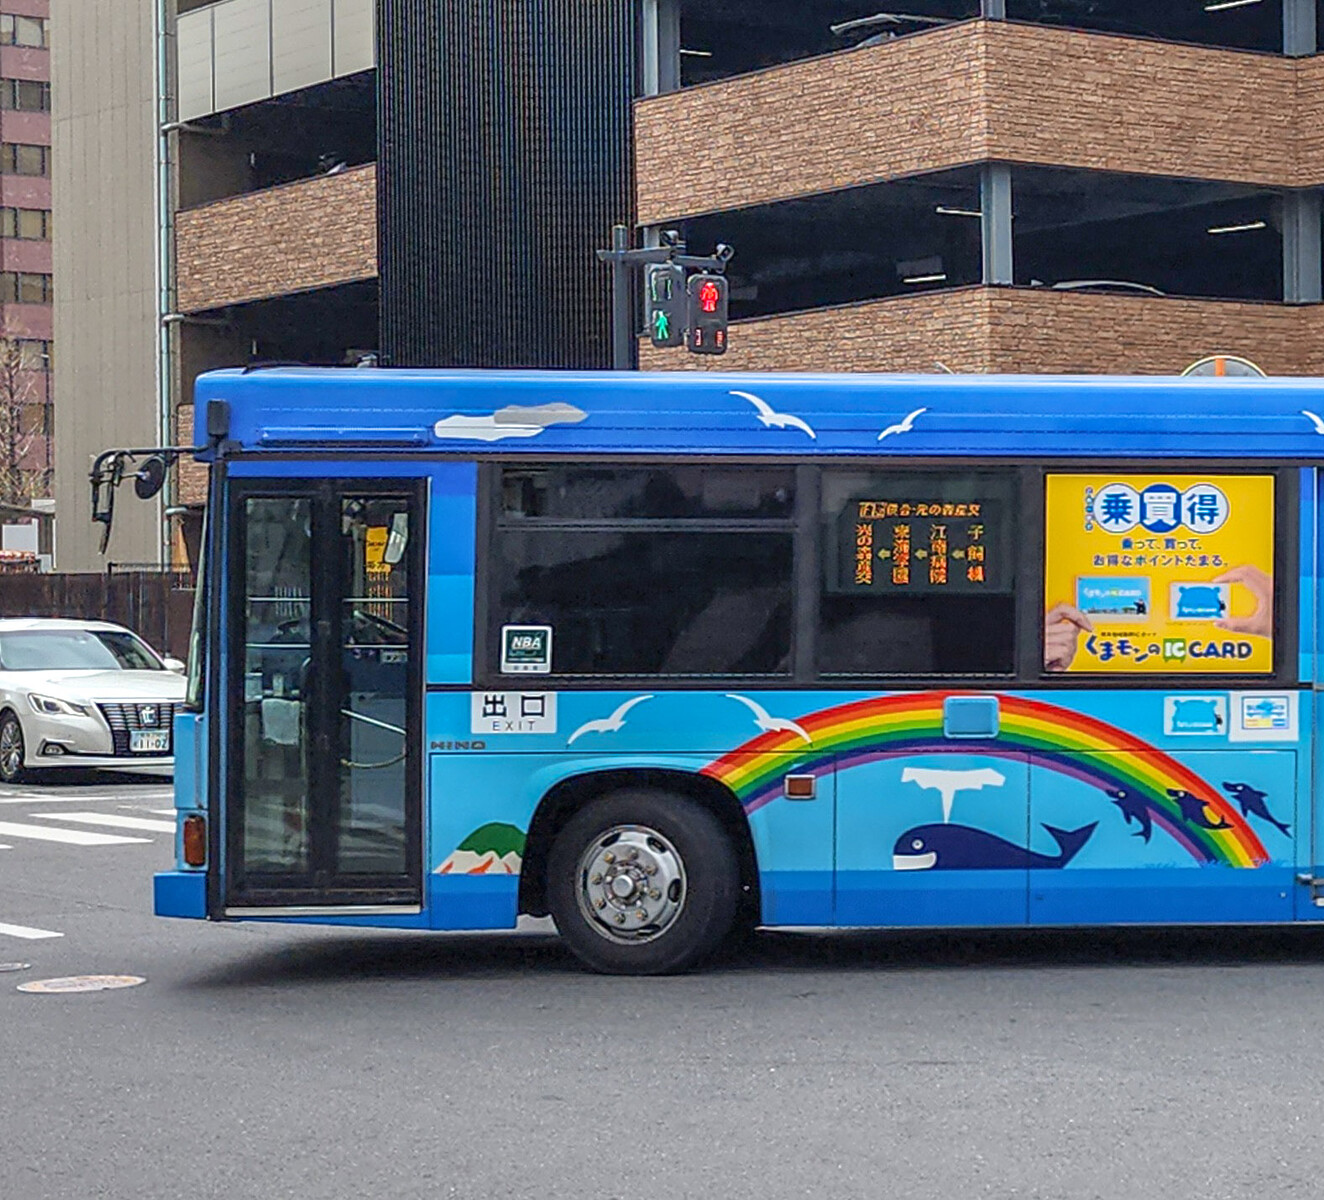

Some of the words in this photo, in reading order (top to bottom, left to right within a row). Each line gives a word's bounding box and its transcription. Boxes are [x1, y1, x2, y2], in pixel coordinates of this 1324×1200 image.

[511, 636, 542, 650] NBA
[1188, 641, 1252, 659] CARD
[482, 694, 545, 717] 出口
[492, 721, 536, 731] EXIT
